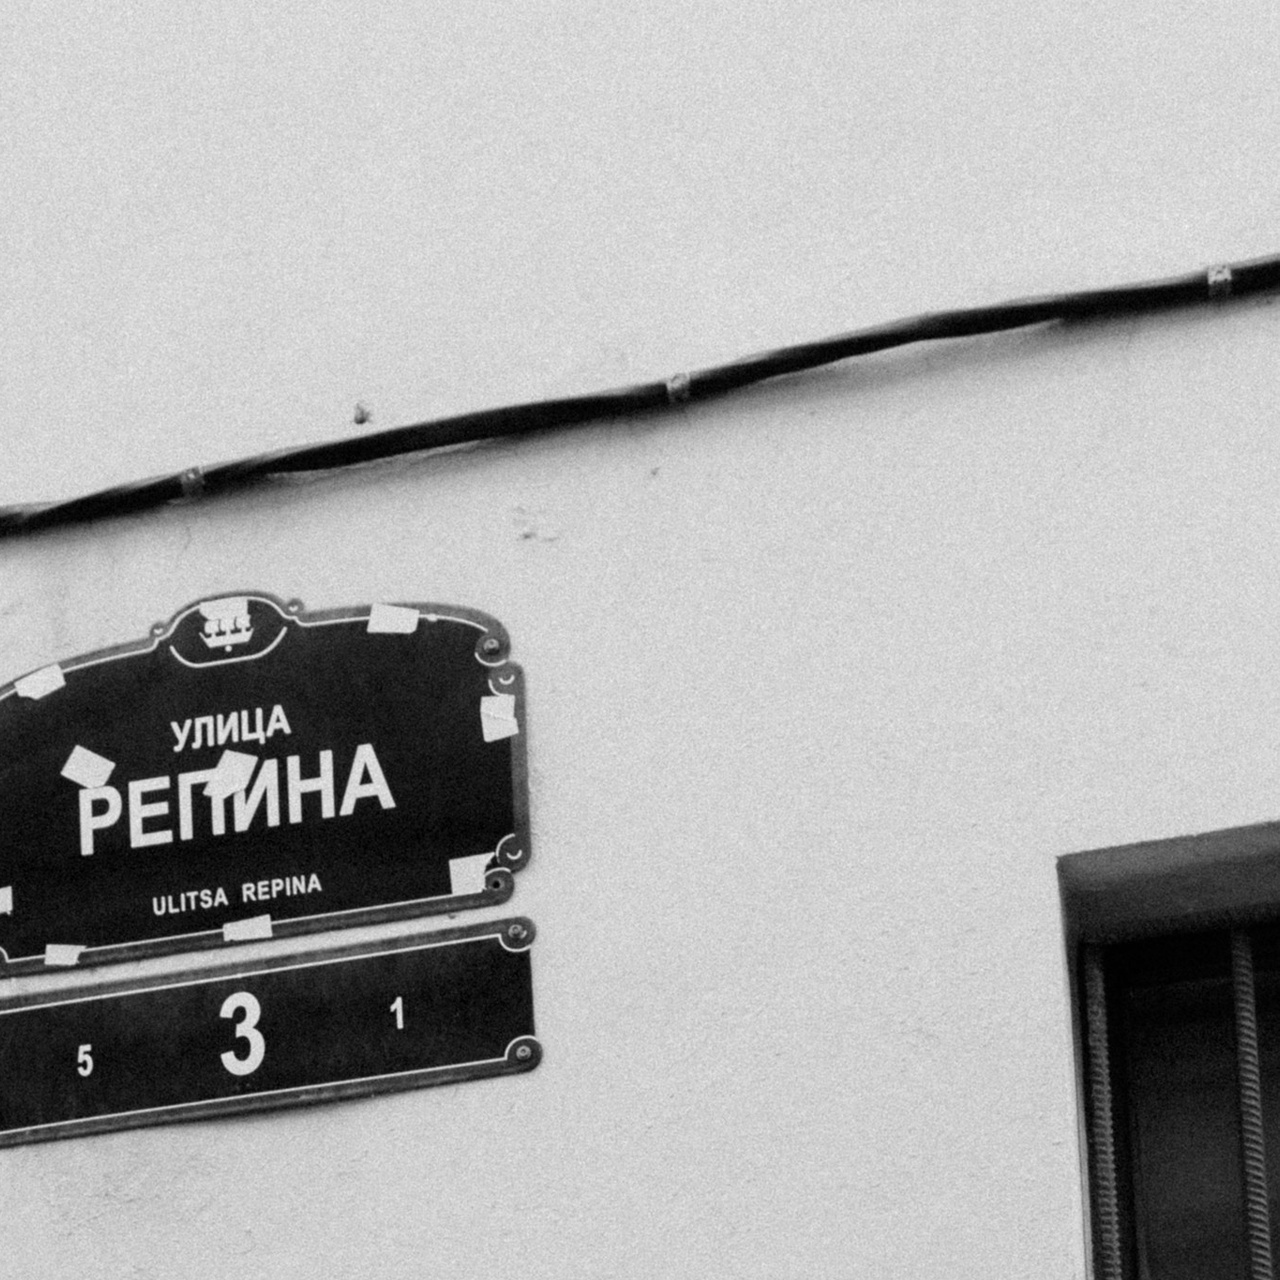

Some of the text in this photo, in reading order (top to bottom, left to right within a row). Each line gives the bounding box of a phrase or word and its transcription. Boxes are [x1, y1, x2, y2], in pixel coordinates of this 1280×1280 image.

[170, 703, 293, 753] УЛИЦА
[77, 742, 397, 857] РЕПИНА
[152, 873, 323, 916] ULITSA REPINA
[77, 991, 404, 1077] 5 3 1
